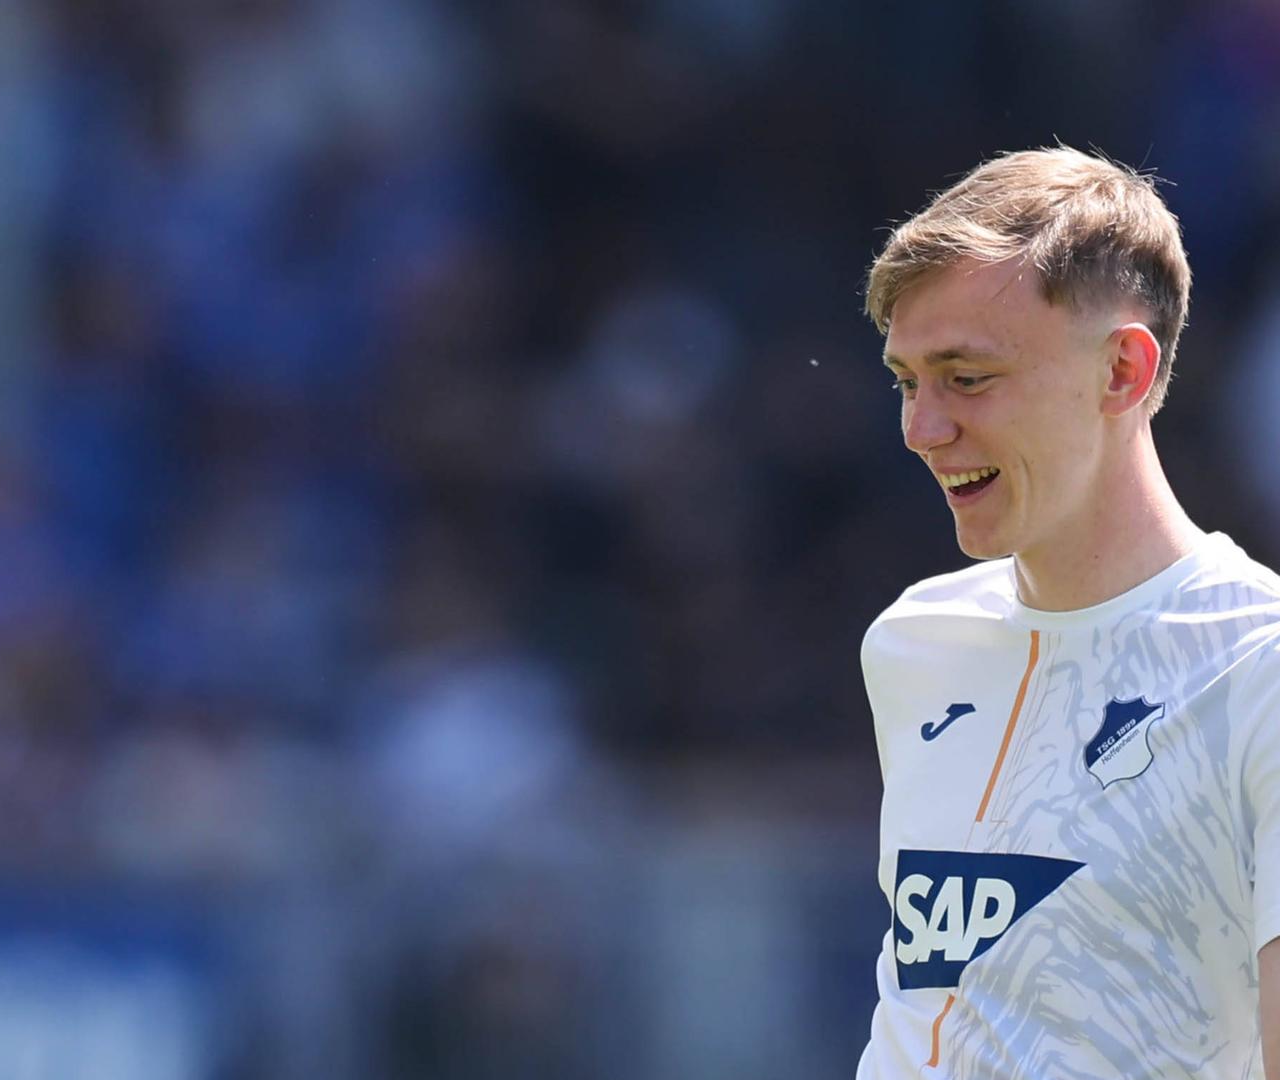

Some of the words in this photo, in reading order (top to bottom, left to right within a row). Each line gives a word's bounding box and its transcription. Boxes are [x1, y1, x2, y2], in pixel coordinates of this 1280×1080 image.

[1096, 736, 1116, 755] TSG
[1116, 718, 1137, 738] 1899
[1100, 728, 1140, 765] Hoffenheim
[895, 873, 1017, 966] SAP
